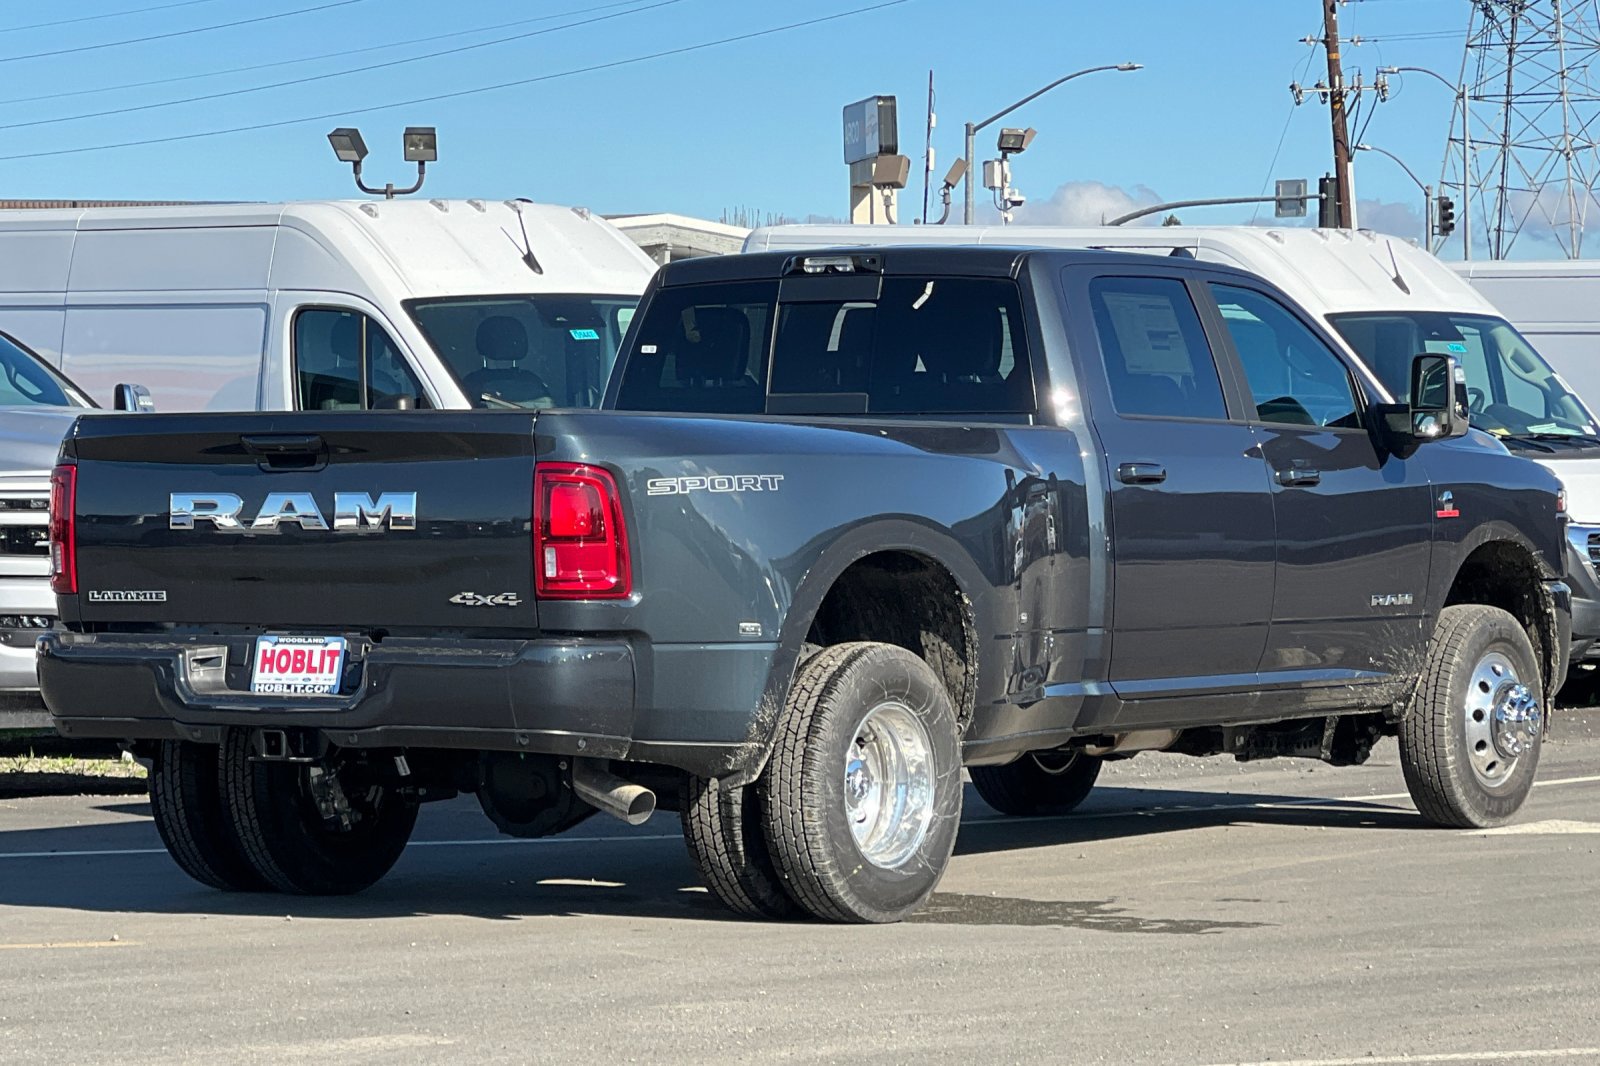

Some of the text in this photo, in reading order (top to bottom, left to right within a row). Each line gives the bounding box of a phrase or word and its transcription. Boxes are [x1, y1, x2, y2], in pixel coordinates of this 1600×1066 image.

[646, 474, 785, 496] SPORT
[170, 491, 417, 530] RAM
[88, 590, 167, 602] LARAMIE
[1371, 593, 1413, 606] RAM
[260, 648, 341, 674] HOBLIT
